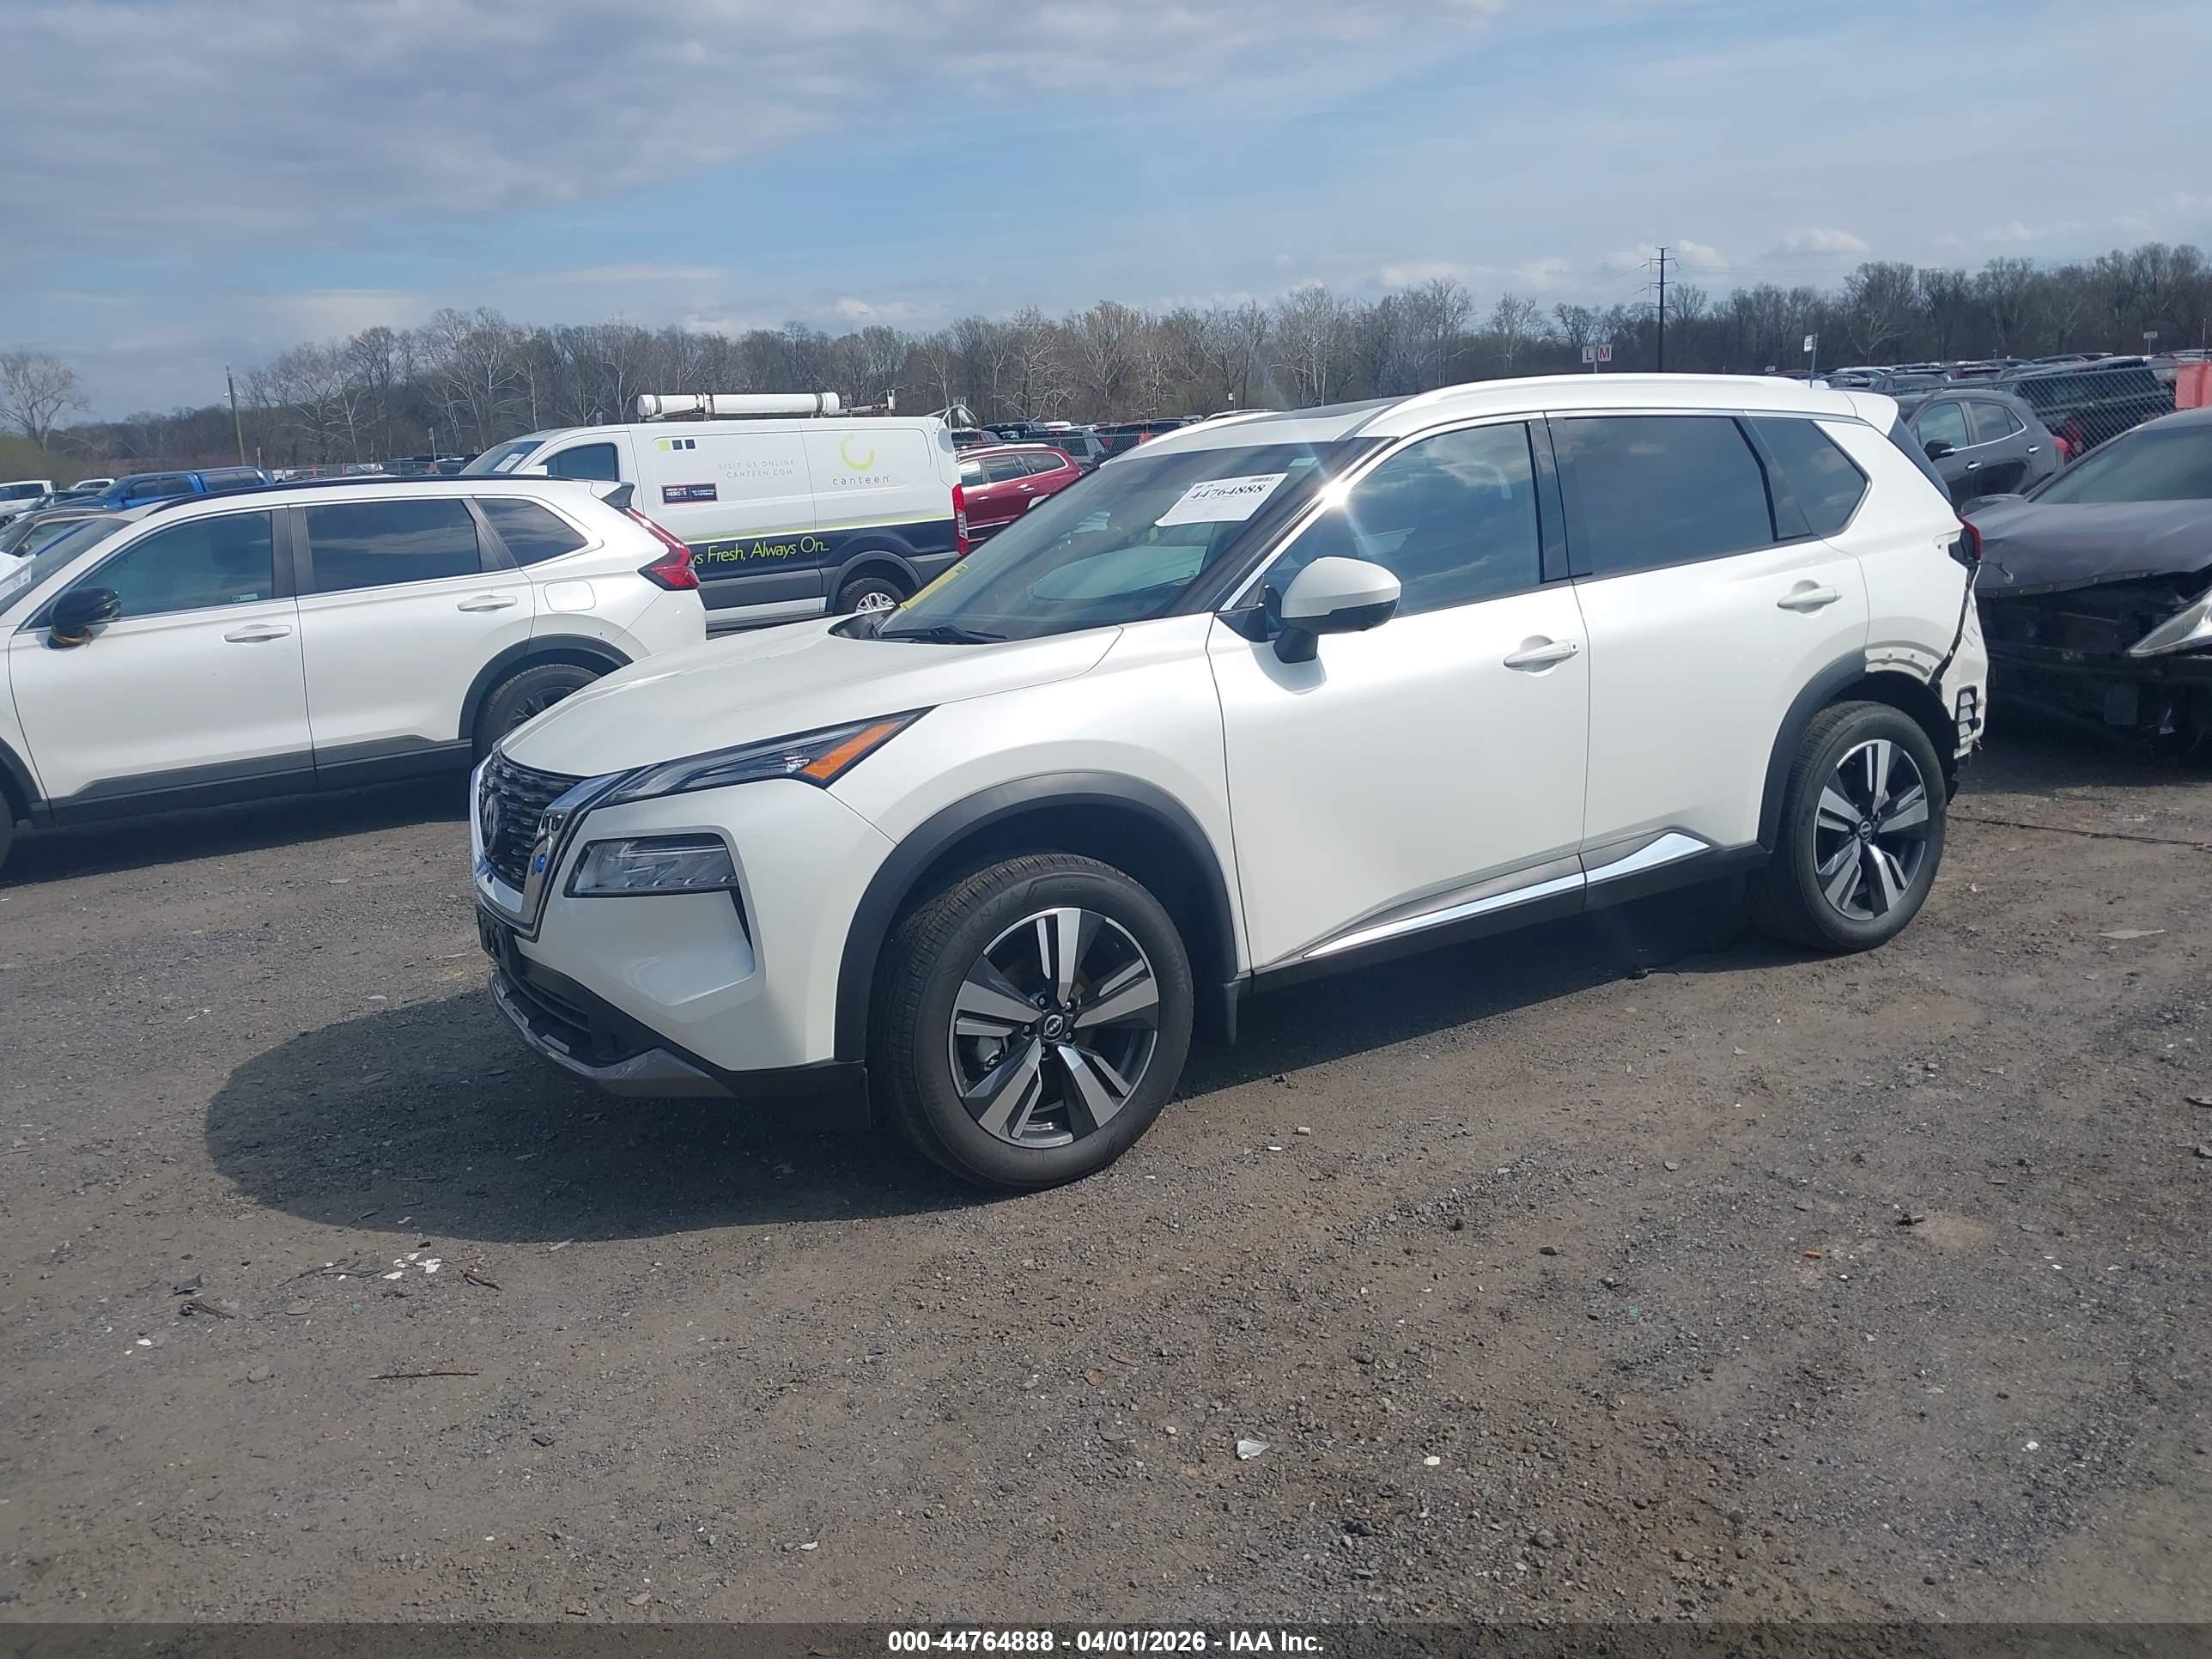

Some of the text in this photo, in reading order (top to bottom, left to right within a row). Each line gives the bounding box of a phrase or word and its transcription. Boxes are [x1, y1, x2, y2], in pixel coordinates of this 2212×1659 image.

[1600, 348, 1609, 358] M
[832, 475, 889, 486] canteen
[1190, 484, 1265, 499] 44764888
[708, 543, 746, 563] Fresh,
[750, 540, 797, 560] Always
